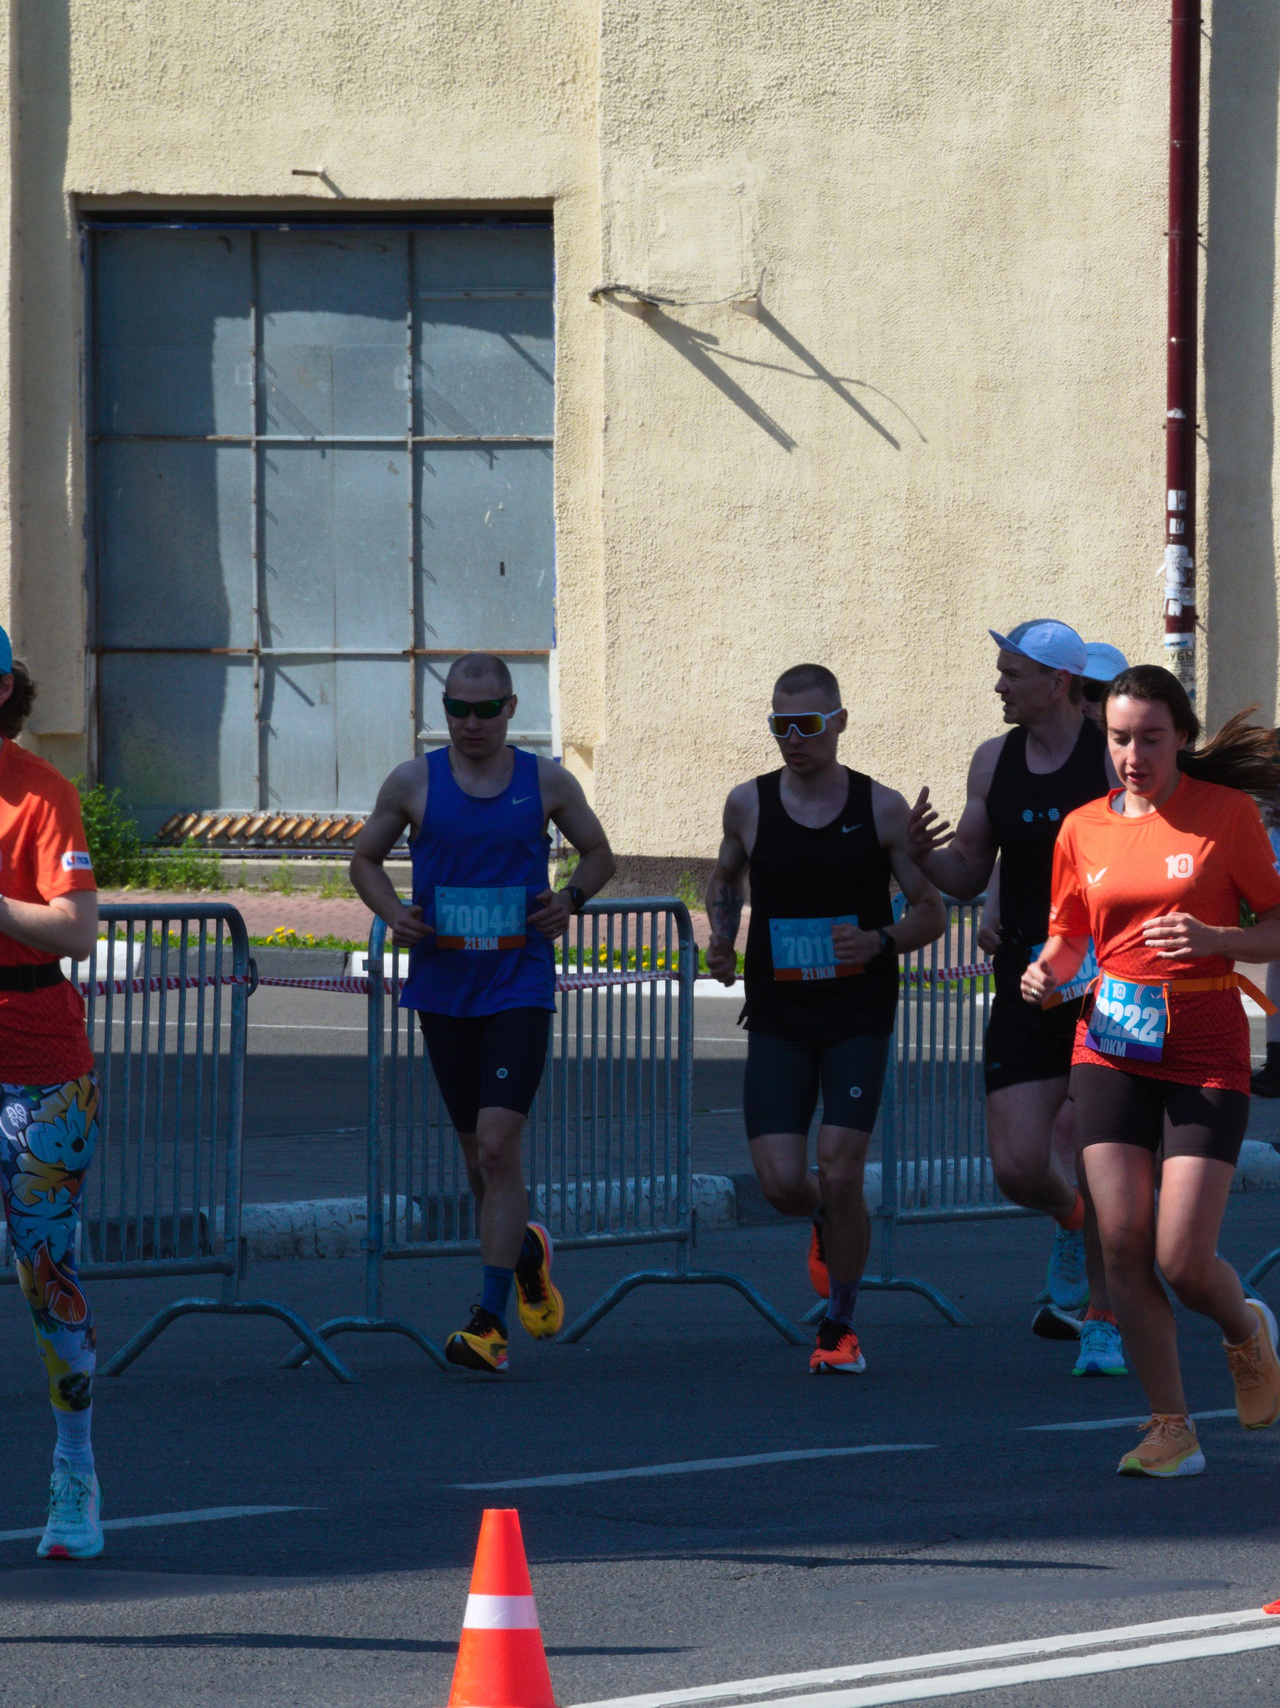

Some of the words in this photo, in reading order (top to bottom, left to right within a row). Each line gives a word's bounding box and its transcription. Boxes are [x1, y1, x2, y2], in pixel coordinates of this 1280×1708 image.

[1165, 853, 1193, 879] 10
[442, 905, 520, 934] 70044
[782, 935, 842, 966] 7011
